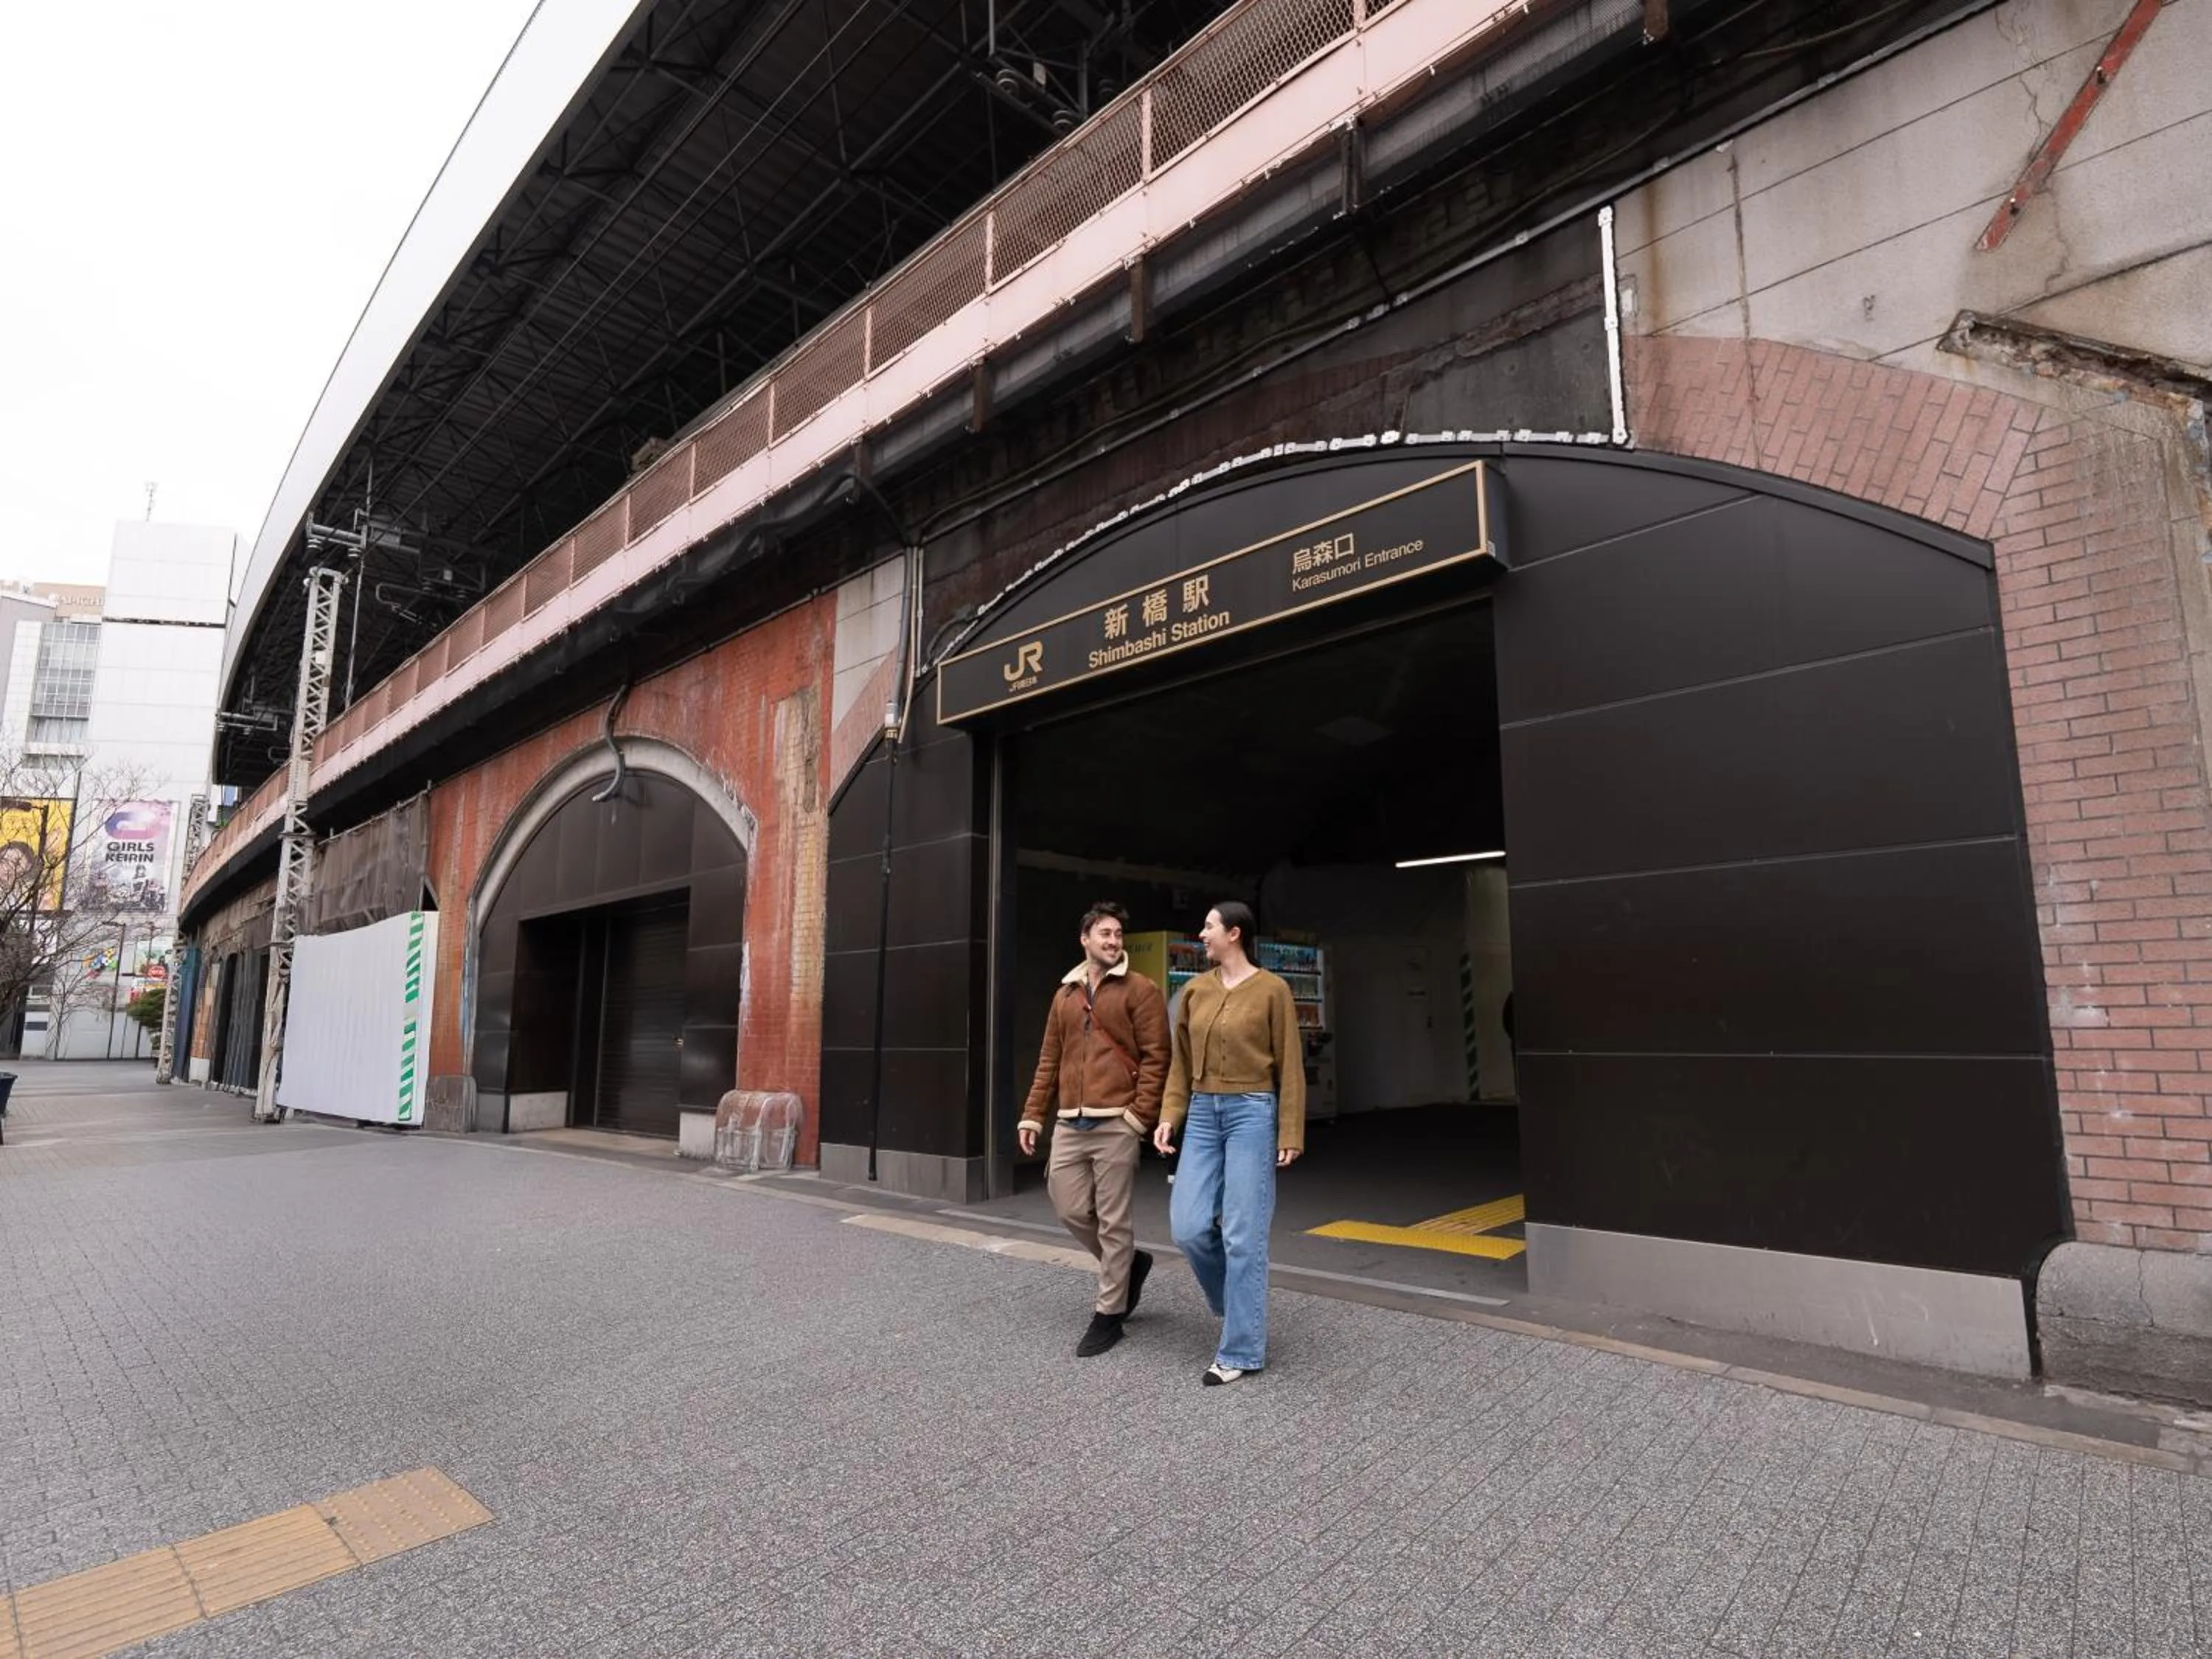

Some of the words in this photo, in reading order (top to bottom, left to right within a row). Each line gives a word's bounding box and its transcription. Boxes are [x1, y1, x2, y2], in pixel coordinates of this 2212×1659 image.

[1293, 557, 1361, 592] Karasumori
[1365, 539, 1424, 568] Entrance
[1104, 574, 1210, 639] 新橋駅
[1004, 639, 1043, 681] JR
[1088, 627, 1167, 669] Shimbashi
[1171, 611, 1230, 642] Station
[105, 853, 154, 863] KEIRIN
[107, 841, 154, 852] GIRLS
